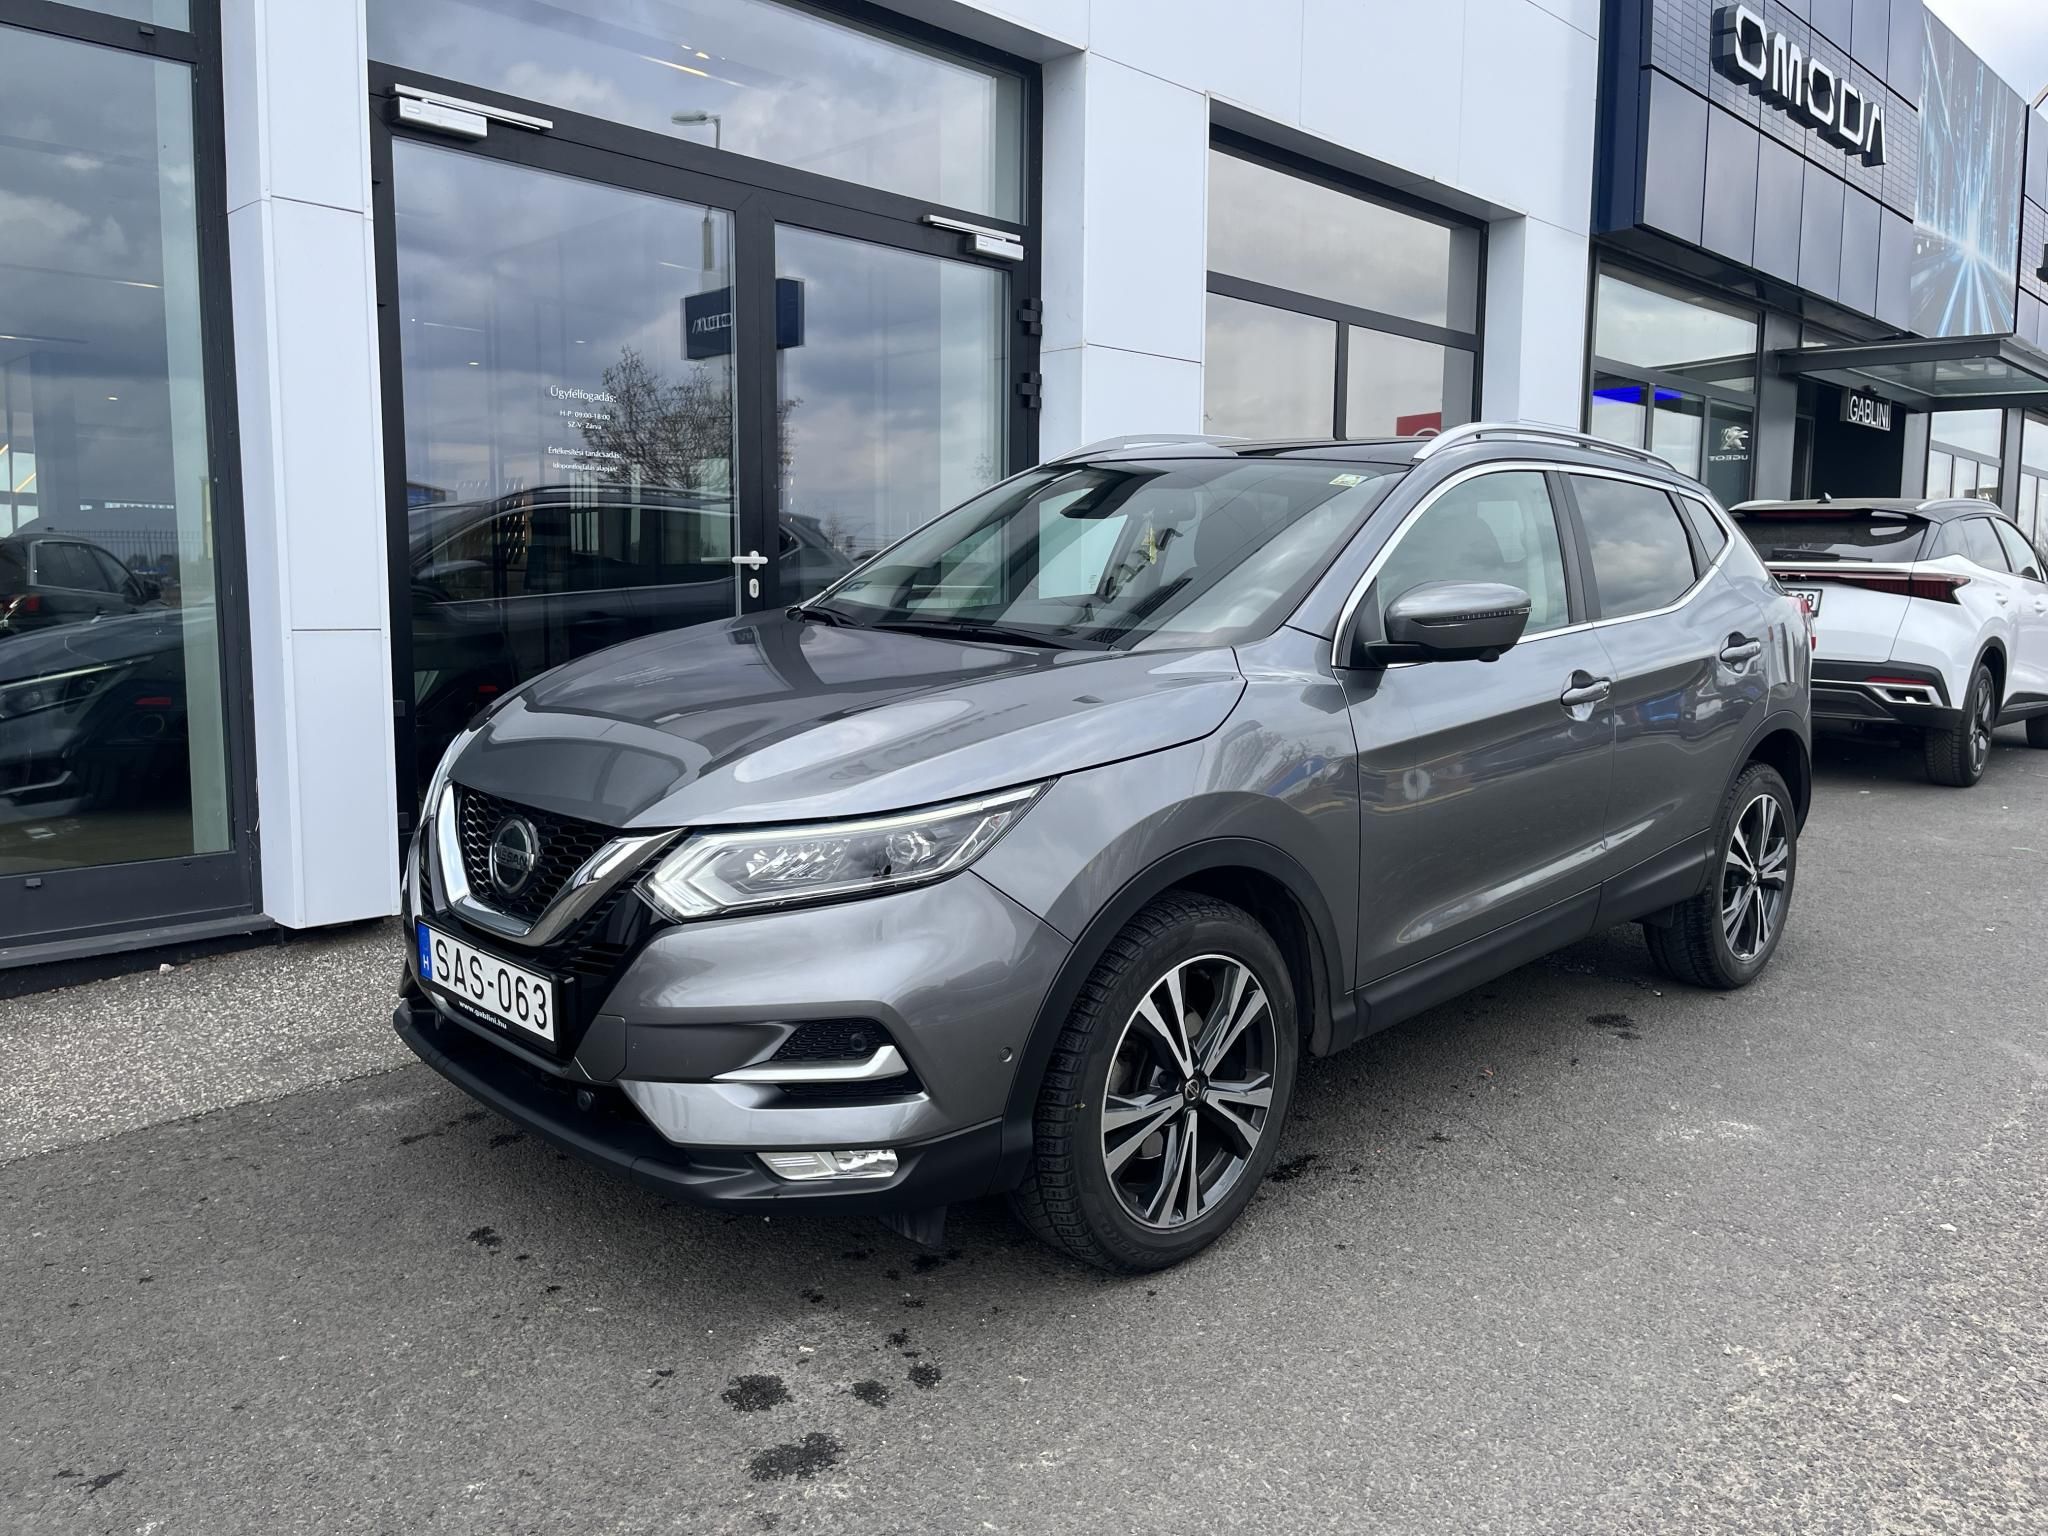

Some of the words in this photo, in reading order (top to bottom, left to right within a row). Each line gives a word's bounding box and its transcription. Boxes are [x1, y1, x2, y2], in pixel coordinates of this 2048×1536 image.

[1718, 4, 1887, 167] OMODA
[550, 384, 617, 403] Ügyfélfogadás:
[585, 422, 602, 430] Zárva
[1849, 395, 1890, 430] GABLINI
[422, 954, 430, 971] H
[435, 938, 548, 1031] SAS-063
[458, 1000, 508, 1030] www.gablini.hu
